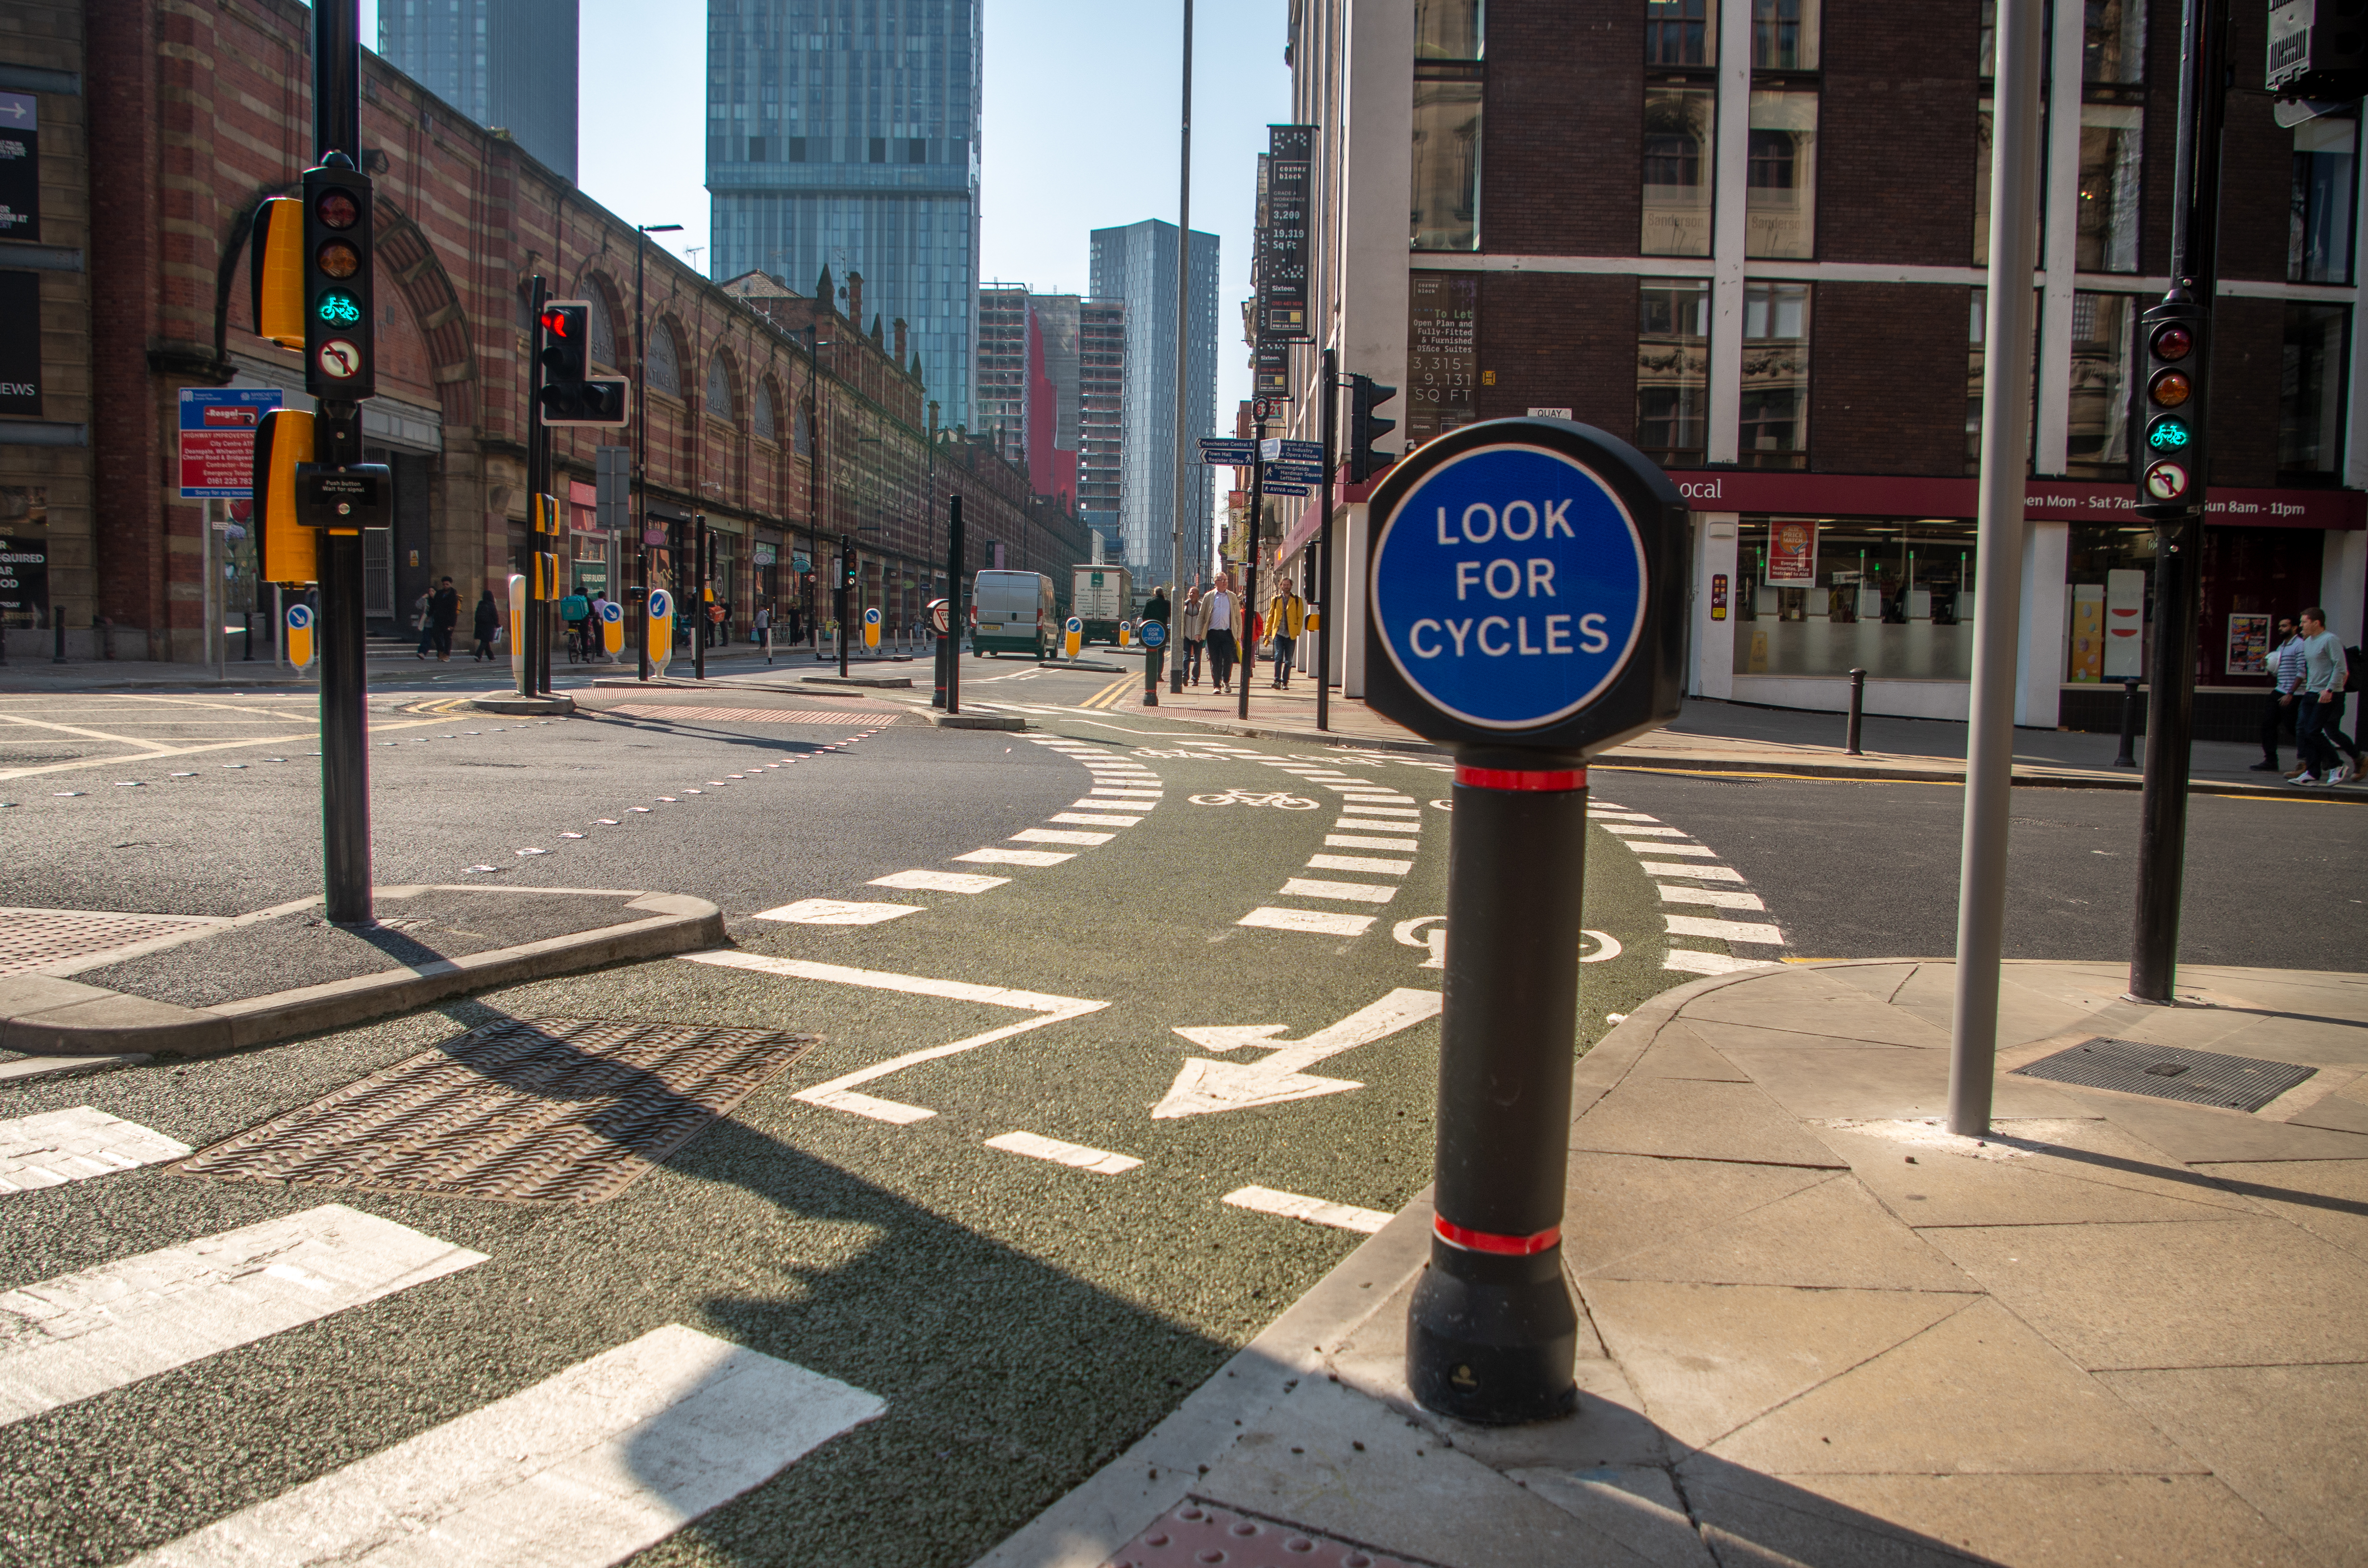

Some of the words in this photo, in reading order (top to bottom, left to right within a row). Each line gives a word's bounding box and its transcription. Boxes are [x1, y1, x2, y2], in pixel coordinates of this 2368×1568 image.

[1274, 210, 1300, 220] 3,200
[1648, 214, 1703, 227] Sanderson
[1273, 229, 1304, 239] 19,319
[1273, 241, 1283, 250] Sq
[1287, 241, 1296, 249] Ft
[1435, 309, 1447, 318] To
[1455, 309, 1473, 318] Let
[1414, 319, 1432, 327] Open
[1418, 328, 1473, 336] Fully-Fitted
[1413, 357, 1472, 371] 3,315-
[647, 367, 680, 393] NTINENT
[1425, 373, 1470, 387] 9,131
[0, 382, 36, 396] EWS
[1416, 388, 1440, 403] SQ
[1451, 390, 1471, 401] FT
[706, 394, 728, 416] NGLAND
[1538, 409, 1562, 418] QUAY
[1669, 478, 1722, 498] ocal
[2024, 496, 2044, 506] en
[2047, 495, 2076, 508] Mon
[2089, 496, 2111, 509] Sat
[2229, 501, 2258, 514] 8am
[2270, 502, 2305, 518] 11pm
[1437, 498, 1576, 545] LOOK
[1456, 558, 1556, 600] FOR
[1409, 612, 1610, 659] CYCLES
